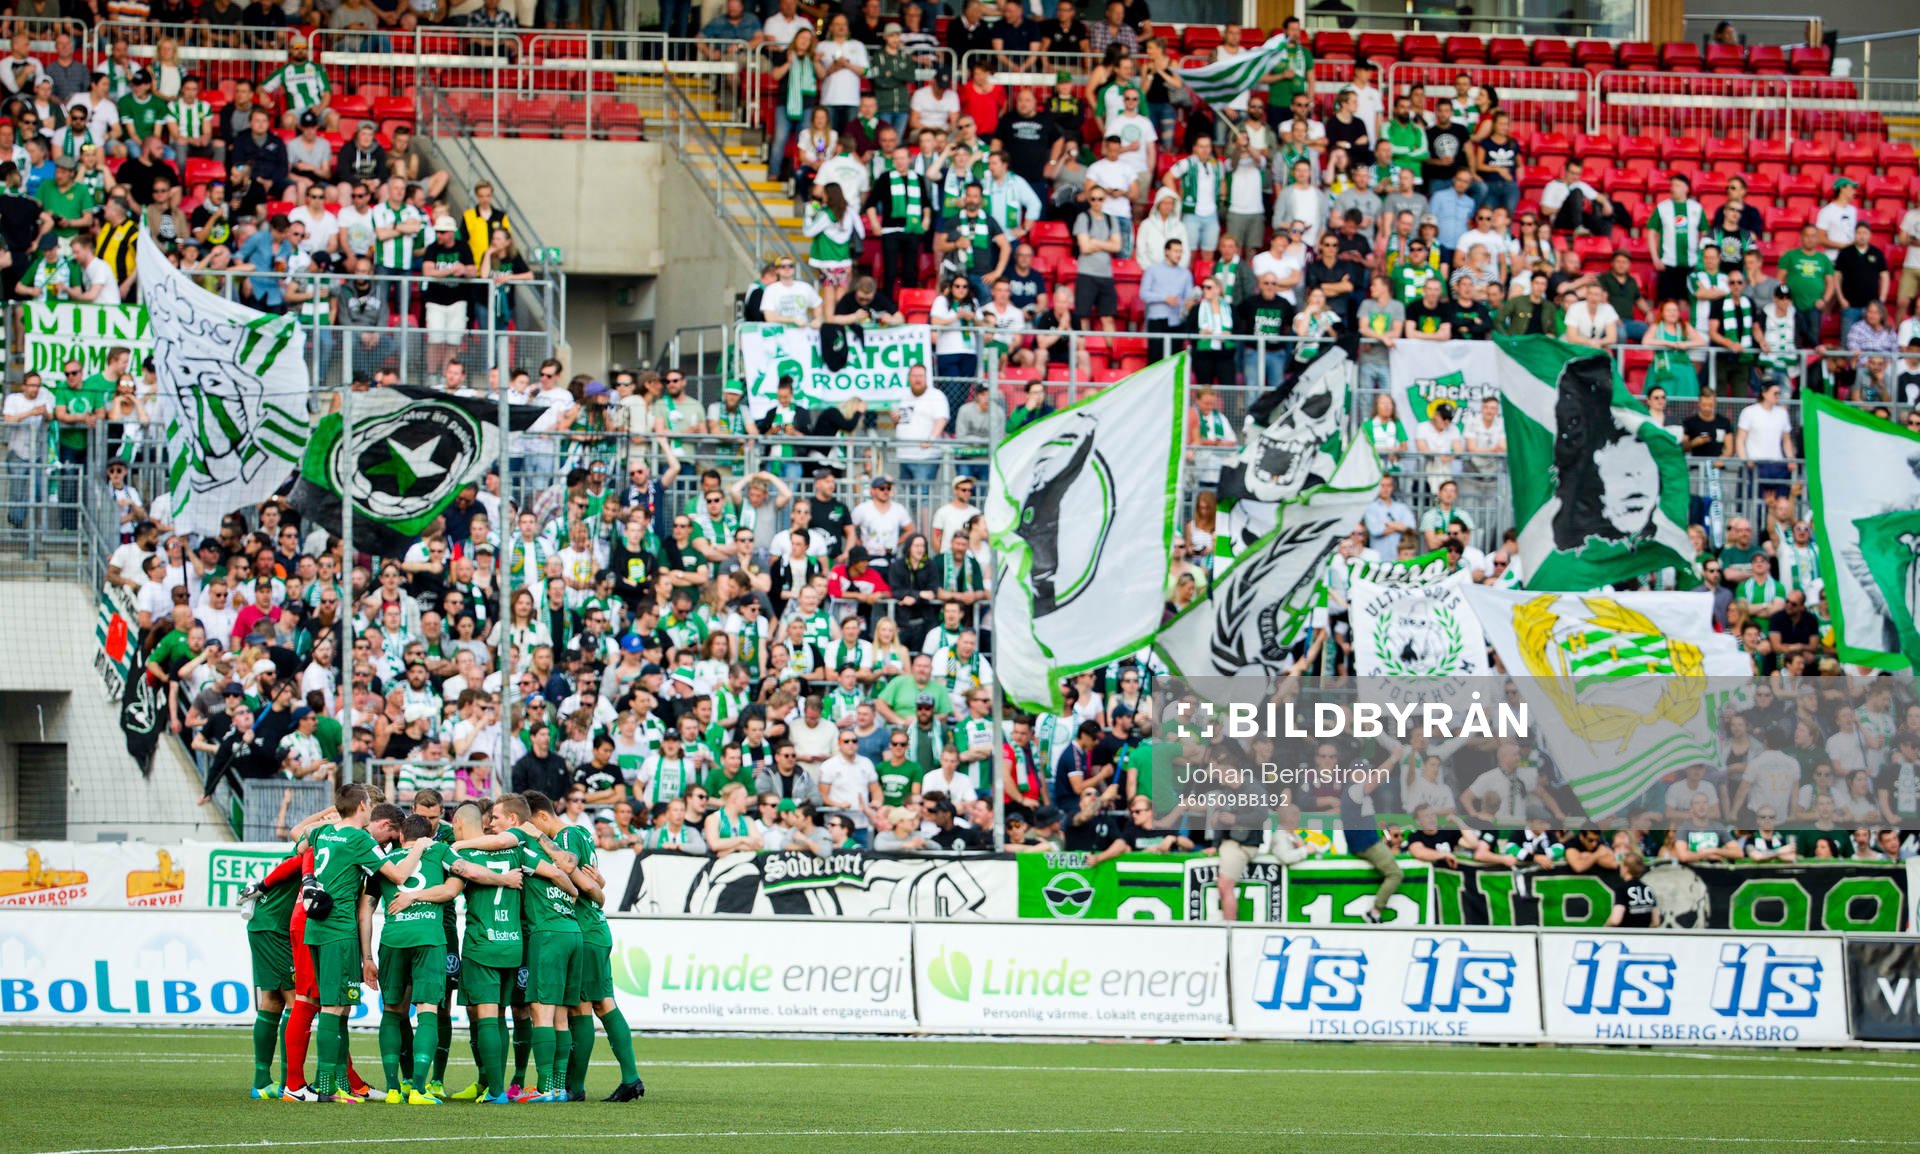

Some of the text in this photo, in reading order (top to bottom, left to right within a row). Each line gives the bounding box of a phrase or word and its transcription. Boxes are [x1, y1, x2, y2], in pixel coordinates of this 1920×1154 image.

[31, 337, 154, 377] DRÖMA
[812, 372, 912, 391] PROGRA
[1368, 659, 1476, 706] STOCKHOLM
[216, 859, 279, 879] SEKT
[486, 861, 510, 906] 7
[1194, 864, 1279, 884] ULRAS
[128, 894, 183, 907] ORVB
[494, 909, 510, 922] ALEX
[661, 953, 905, 1003] Linde energi
[981, 958, 1220, 1007] Linde energi
[1250, 935, 1517, 1013] its its
[1562, 940, 1824, 1018] its its
[1877, 976, 1920, 1016] V
[661, 1003, 912, 1020] Personlig värme. Lokalt engagemang.
[982, 1007, 1228, 1024] Personlig värme. Lokalt engagemang.
[1309, 1019, 1470, 1036] ITSLOGISTIK.SE
